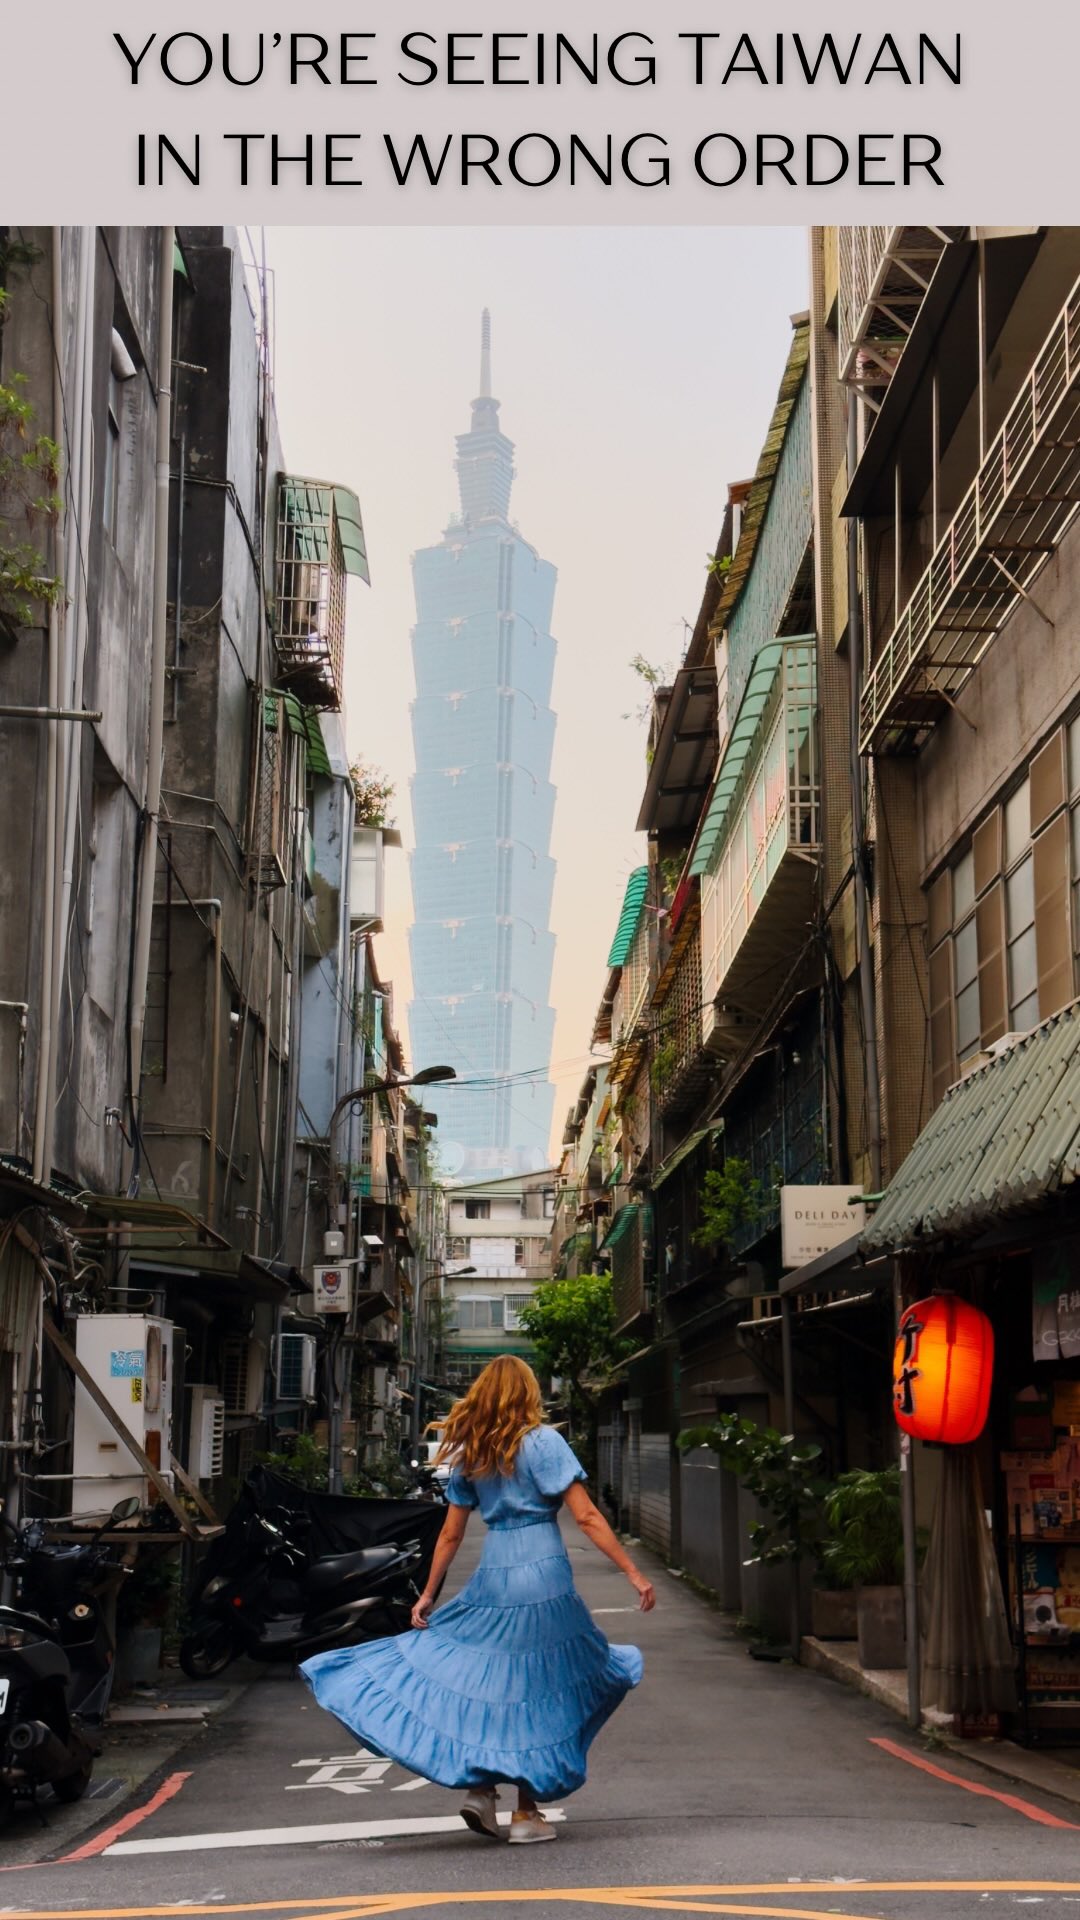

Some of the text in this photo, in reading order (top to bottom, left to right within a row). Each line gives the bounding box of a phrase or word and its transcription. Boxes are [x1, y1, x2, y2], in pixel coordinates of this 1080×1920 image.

[794, 1210, 857, 1220] DELI DAY
[112, 1351, 143, 1368] 冷氣
